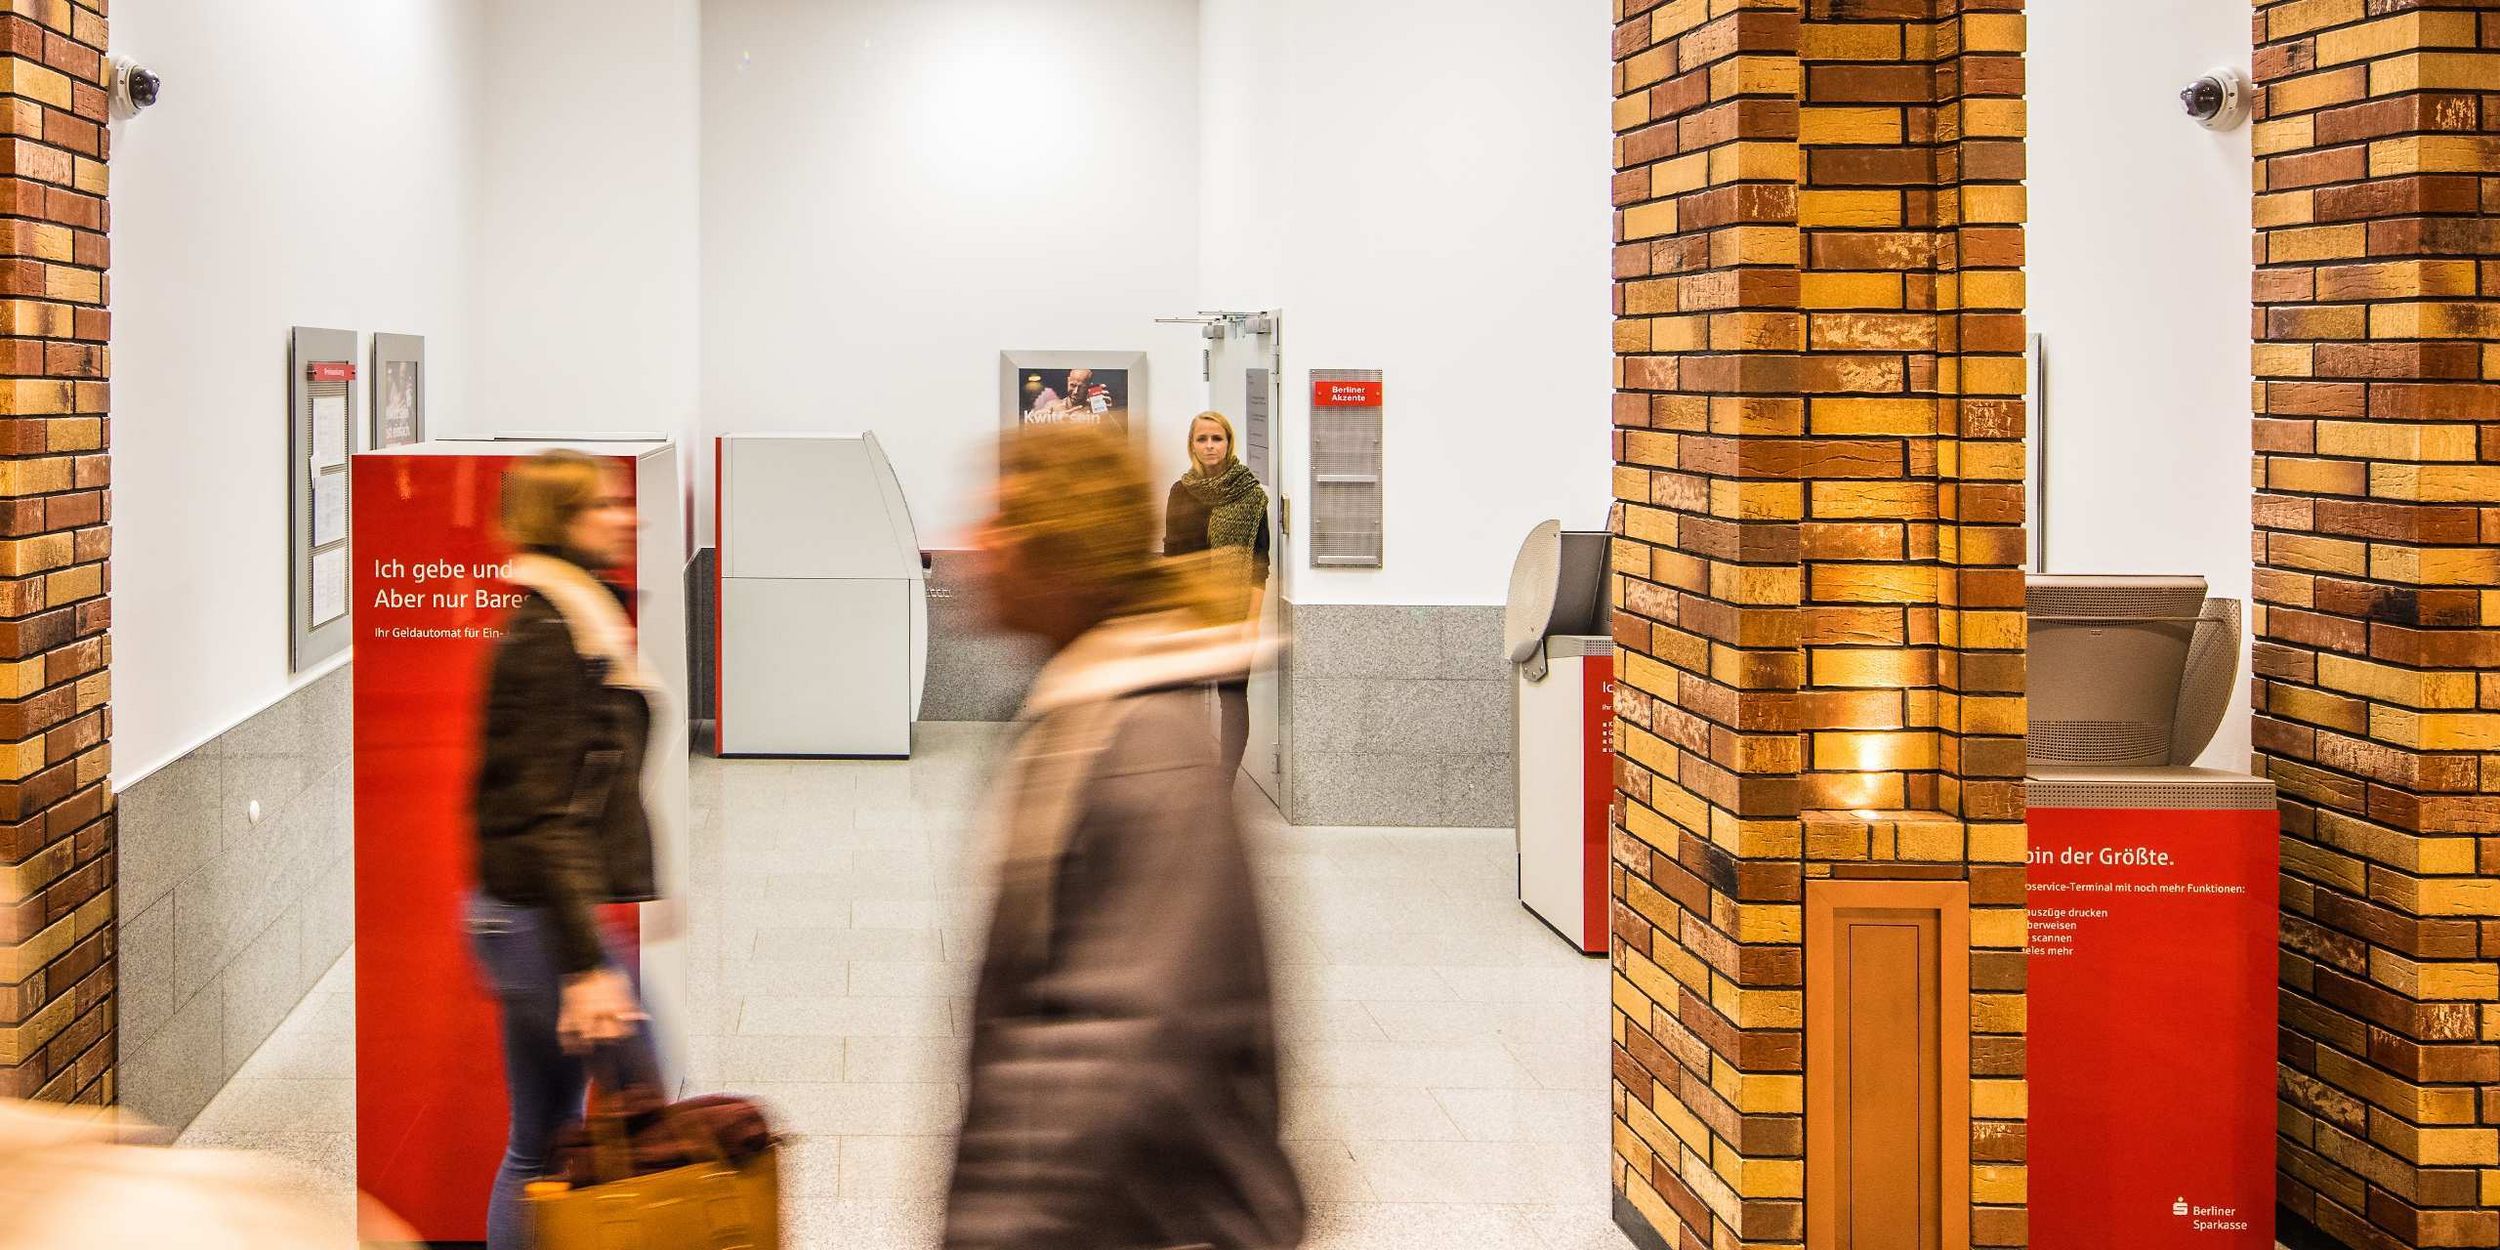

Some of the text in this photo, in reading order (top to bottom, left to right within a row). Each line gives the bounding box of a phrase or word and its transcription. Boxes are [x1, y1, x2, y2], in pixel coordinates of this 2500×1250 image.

[1332, 386, 1366, 394] Berliner
[1332, 394, 1366, 402] Akzente
[375, 558, 513, 583] Ich gebe und
[374, 588, 426, 608] Aber
[433, 593, 469, 608] nur
[375, 627, 389, 638] Ihr
[392, 627, 462, 638] Geldautomat
[464, 627, 479, 638] für
[2060, 846, 2094, 865] der
[2099, 846, 2175, 866] Größte.
[2115, 883, 2132, 892] mit
[2134, 883, 2157, 893] noch
[2159, 883, 2186, 893] mehr
[2187, 883, 2246, 894] Funktionen:
[2068, 908, 2108, 917] drucken
[2027, 920, 2077, 930] berweisen
[2032, 934, 2072, 943] scannen
[2047, 946, 2074, 956] mehr
[2193, 1205, 2236, 1216] Berliner
[2193, 1219, 2248, 1231] Sparkasse
